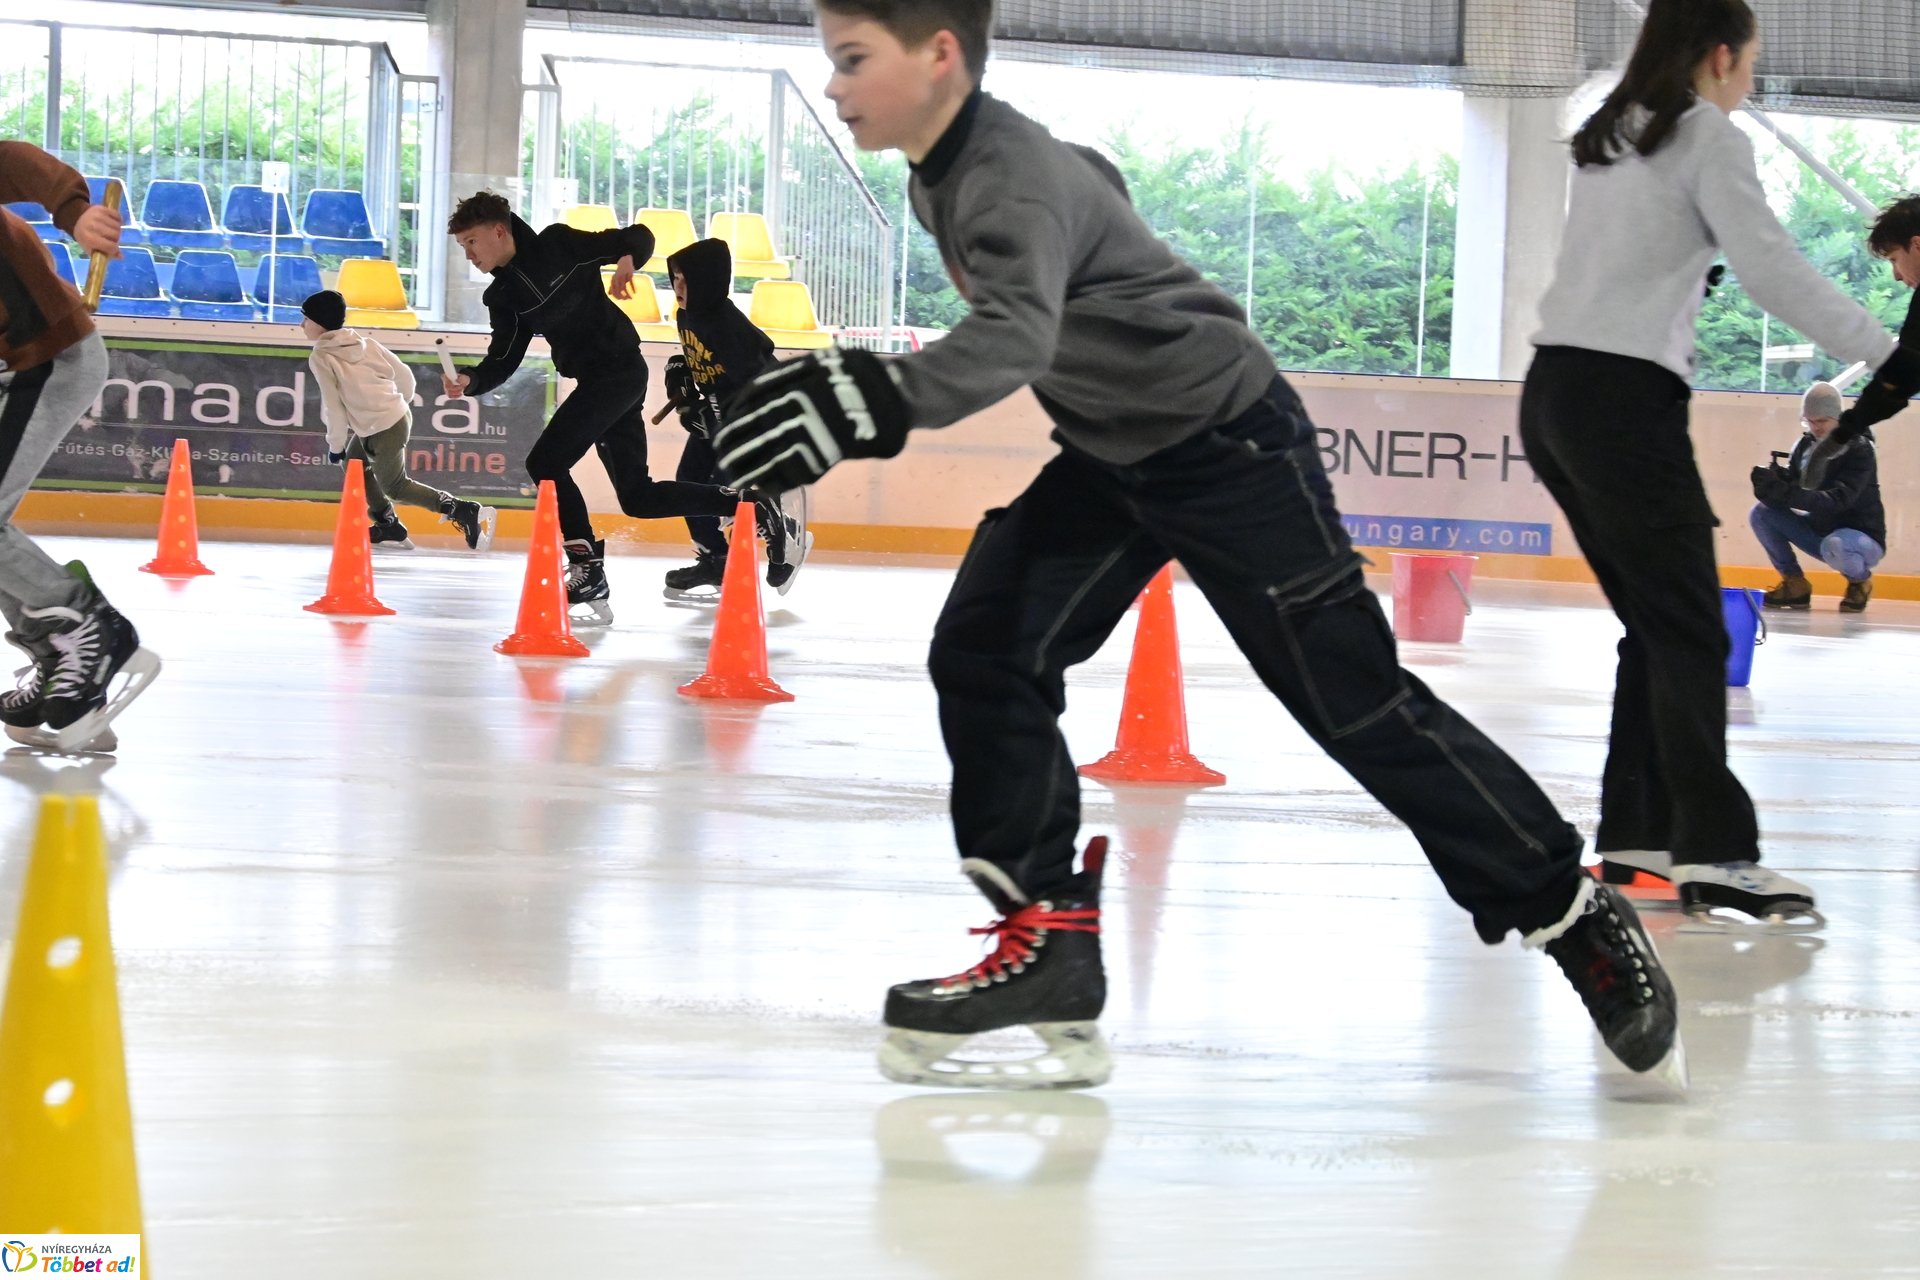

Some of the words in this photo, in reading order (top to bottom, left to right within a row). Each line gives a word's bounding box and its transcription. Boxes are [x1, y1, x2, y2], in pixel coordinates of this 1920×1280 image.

[411, 444, 506, 474] nline
[1315, 427, 1541, 483] BNER-H
[1346, 521, 1543, 548] ungary.com
